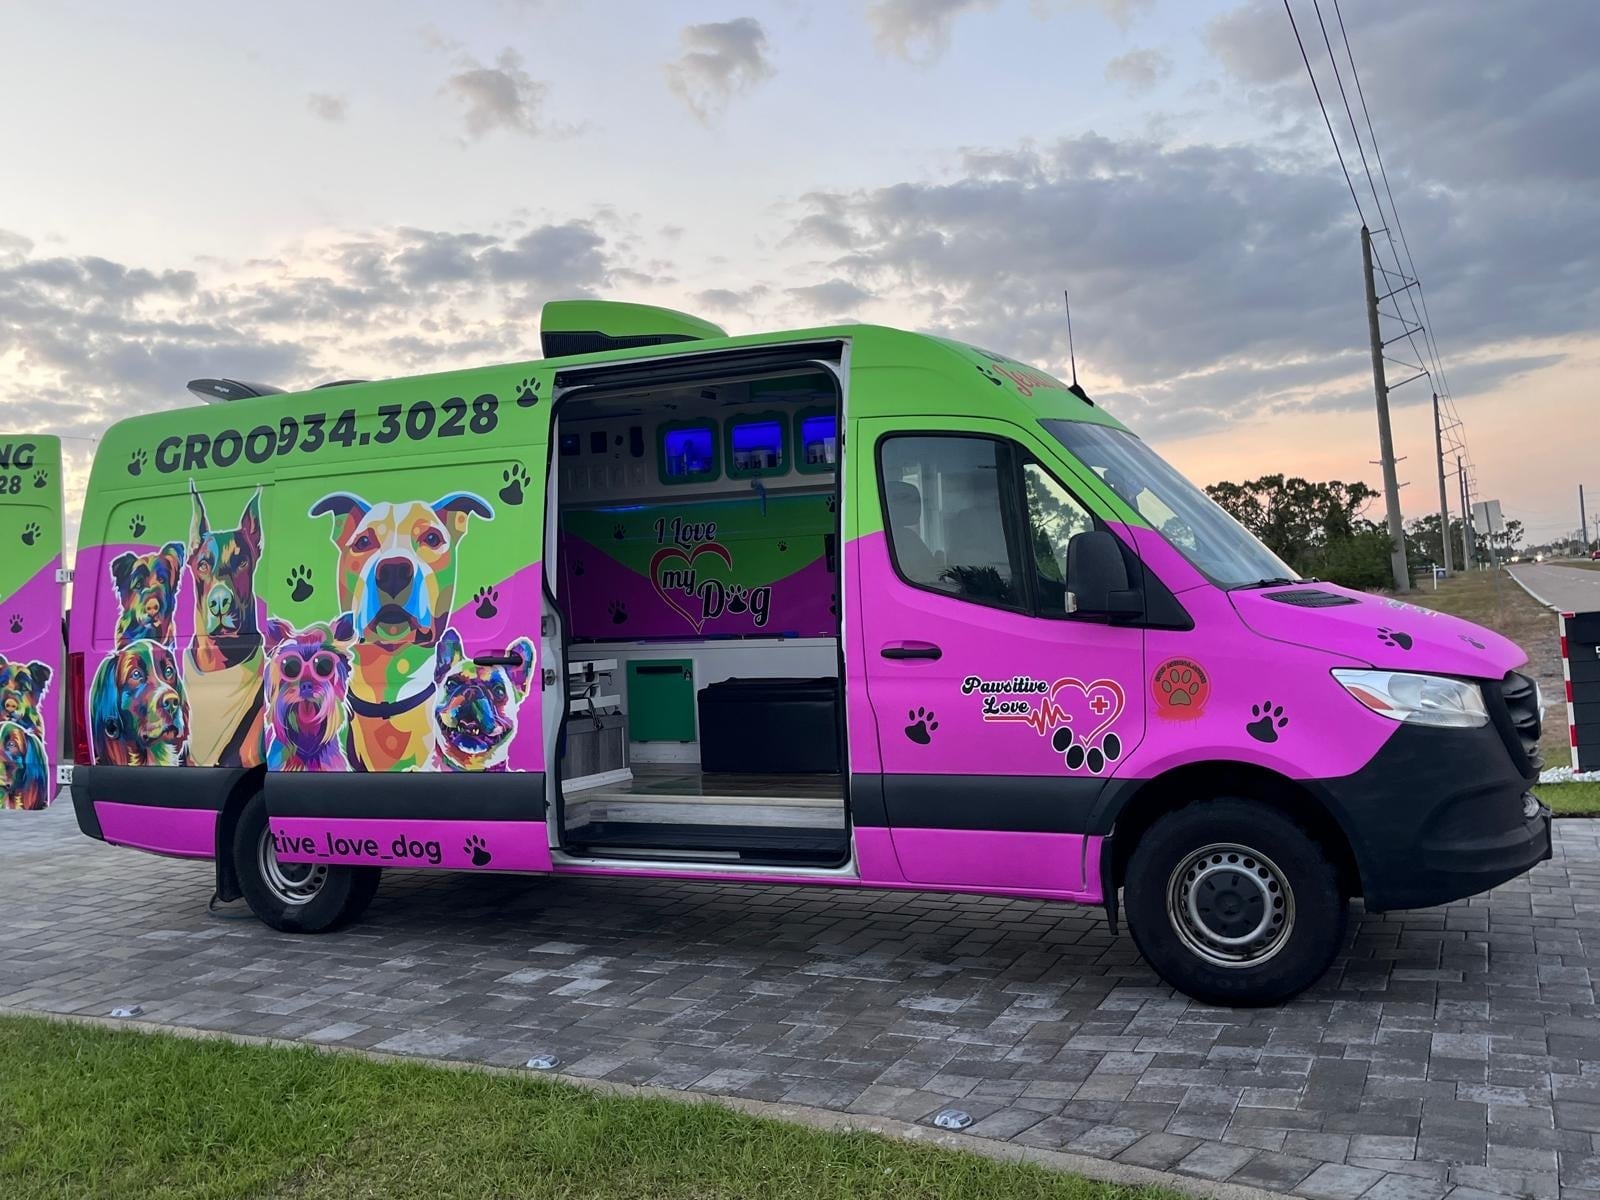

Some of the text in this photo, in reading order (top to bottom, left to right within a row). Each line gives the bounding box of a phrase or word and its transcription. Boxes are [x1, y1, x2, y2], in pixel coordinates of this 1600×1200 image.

[654, 516, 717, 550] I Love
[662, 568, 696, 596] my
[961, 676, 1049, 695] Pawsitive
[982, 696, 1030, 715] Love
